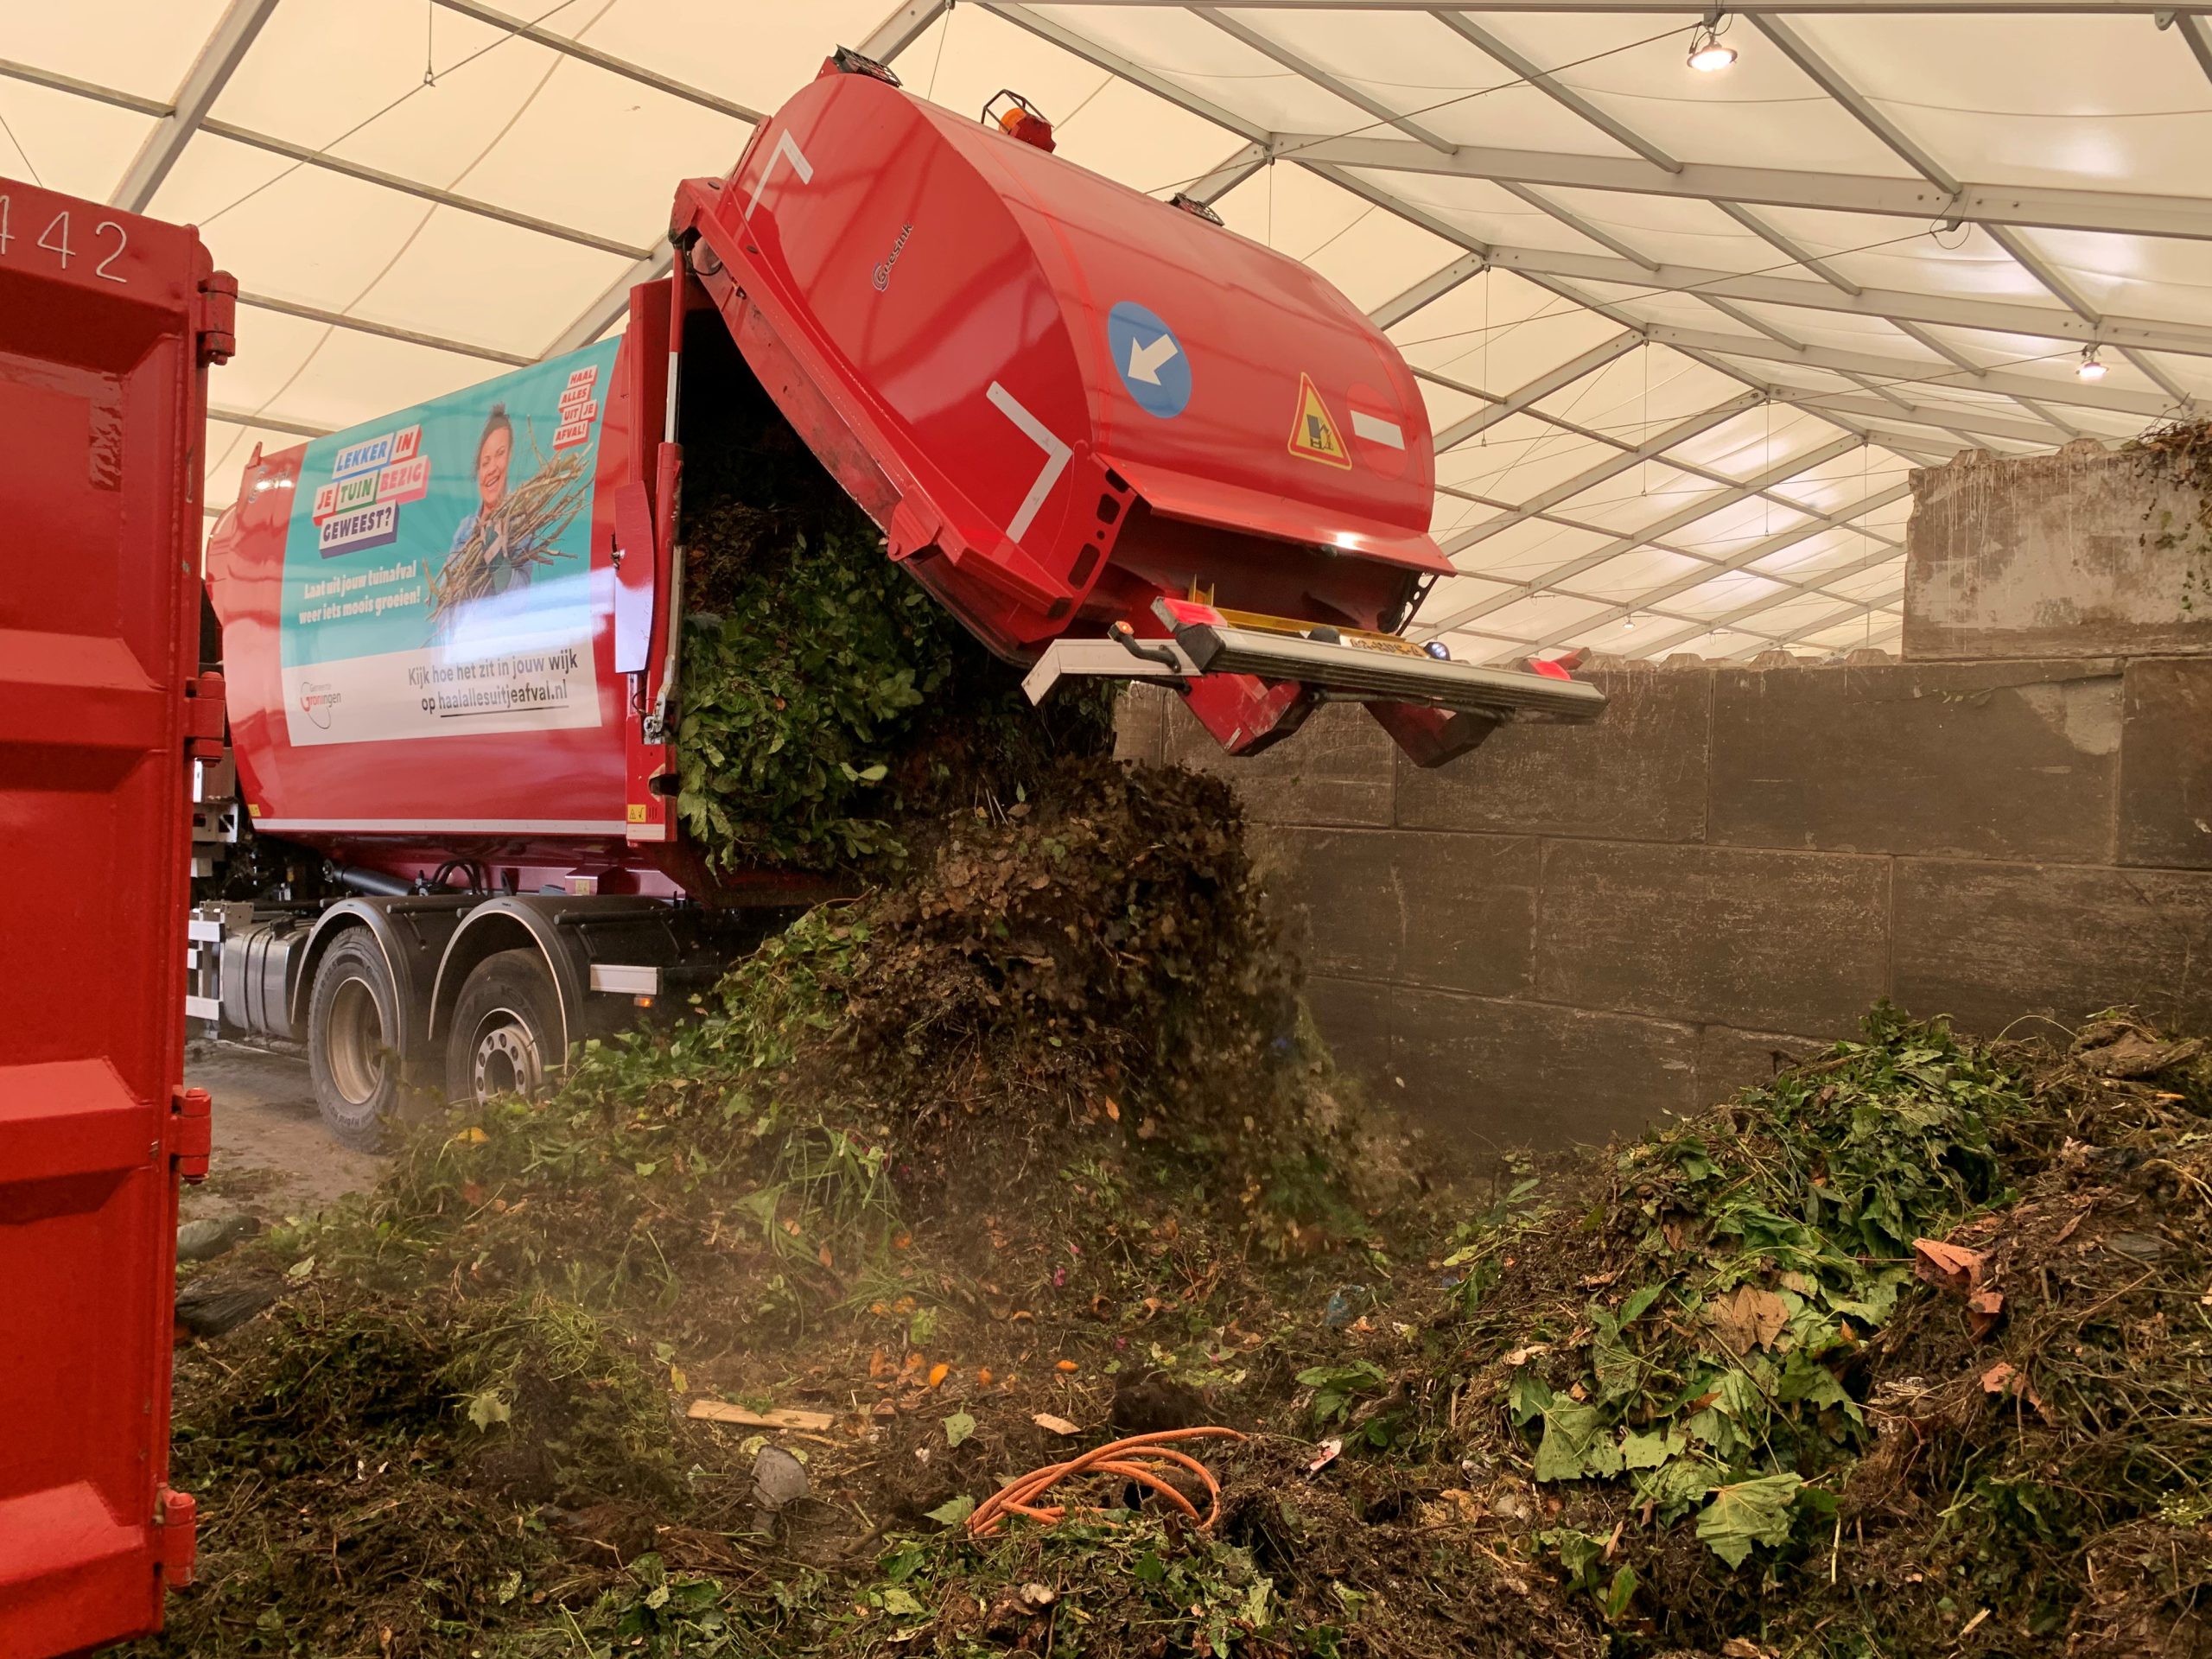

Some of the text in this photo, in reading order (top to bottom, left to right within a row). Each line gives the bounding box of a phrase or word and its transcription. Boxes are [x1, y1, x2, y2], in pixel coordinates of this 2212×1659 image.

[570, 369, 593, 385] HAAL
[561, 388, 588, 404] ALLES
[564, 404, 594, 421] UIT JE
[556, 423, 586, 442] AFVAL!
[336, 432, 414, 472] LEKKER IN
[317, 462, 423, 511] JE TUIN BEZIG
[323, 506, 392, 542] GEWEEST?
[304, 559, 417, 600] Laat uit jouw tuinafval
[299, 585, 422, 625] weer iets moois groeien!
[408, 648, 578, 690] Kijk hoe het zit in jouw wijk
[422, 678, 568, 715] op haalallesuitjeafval.nl
